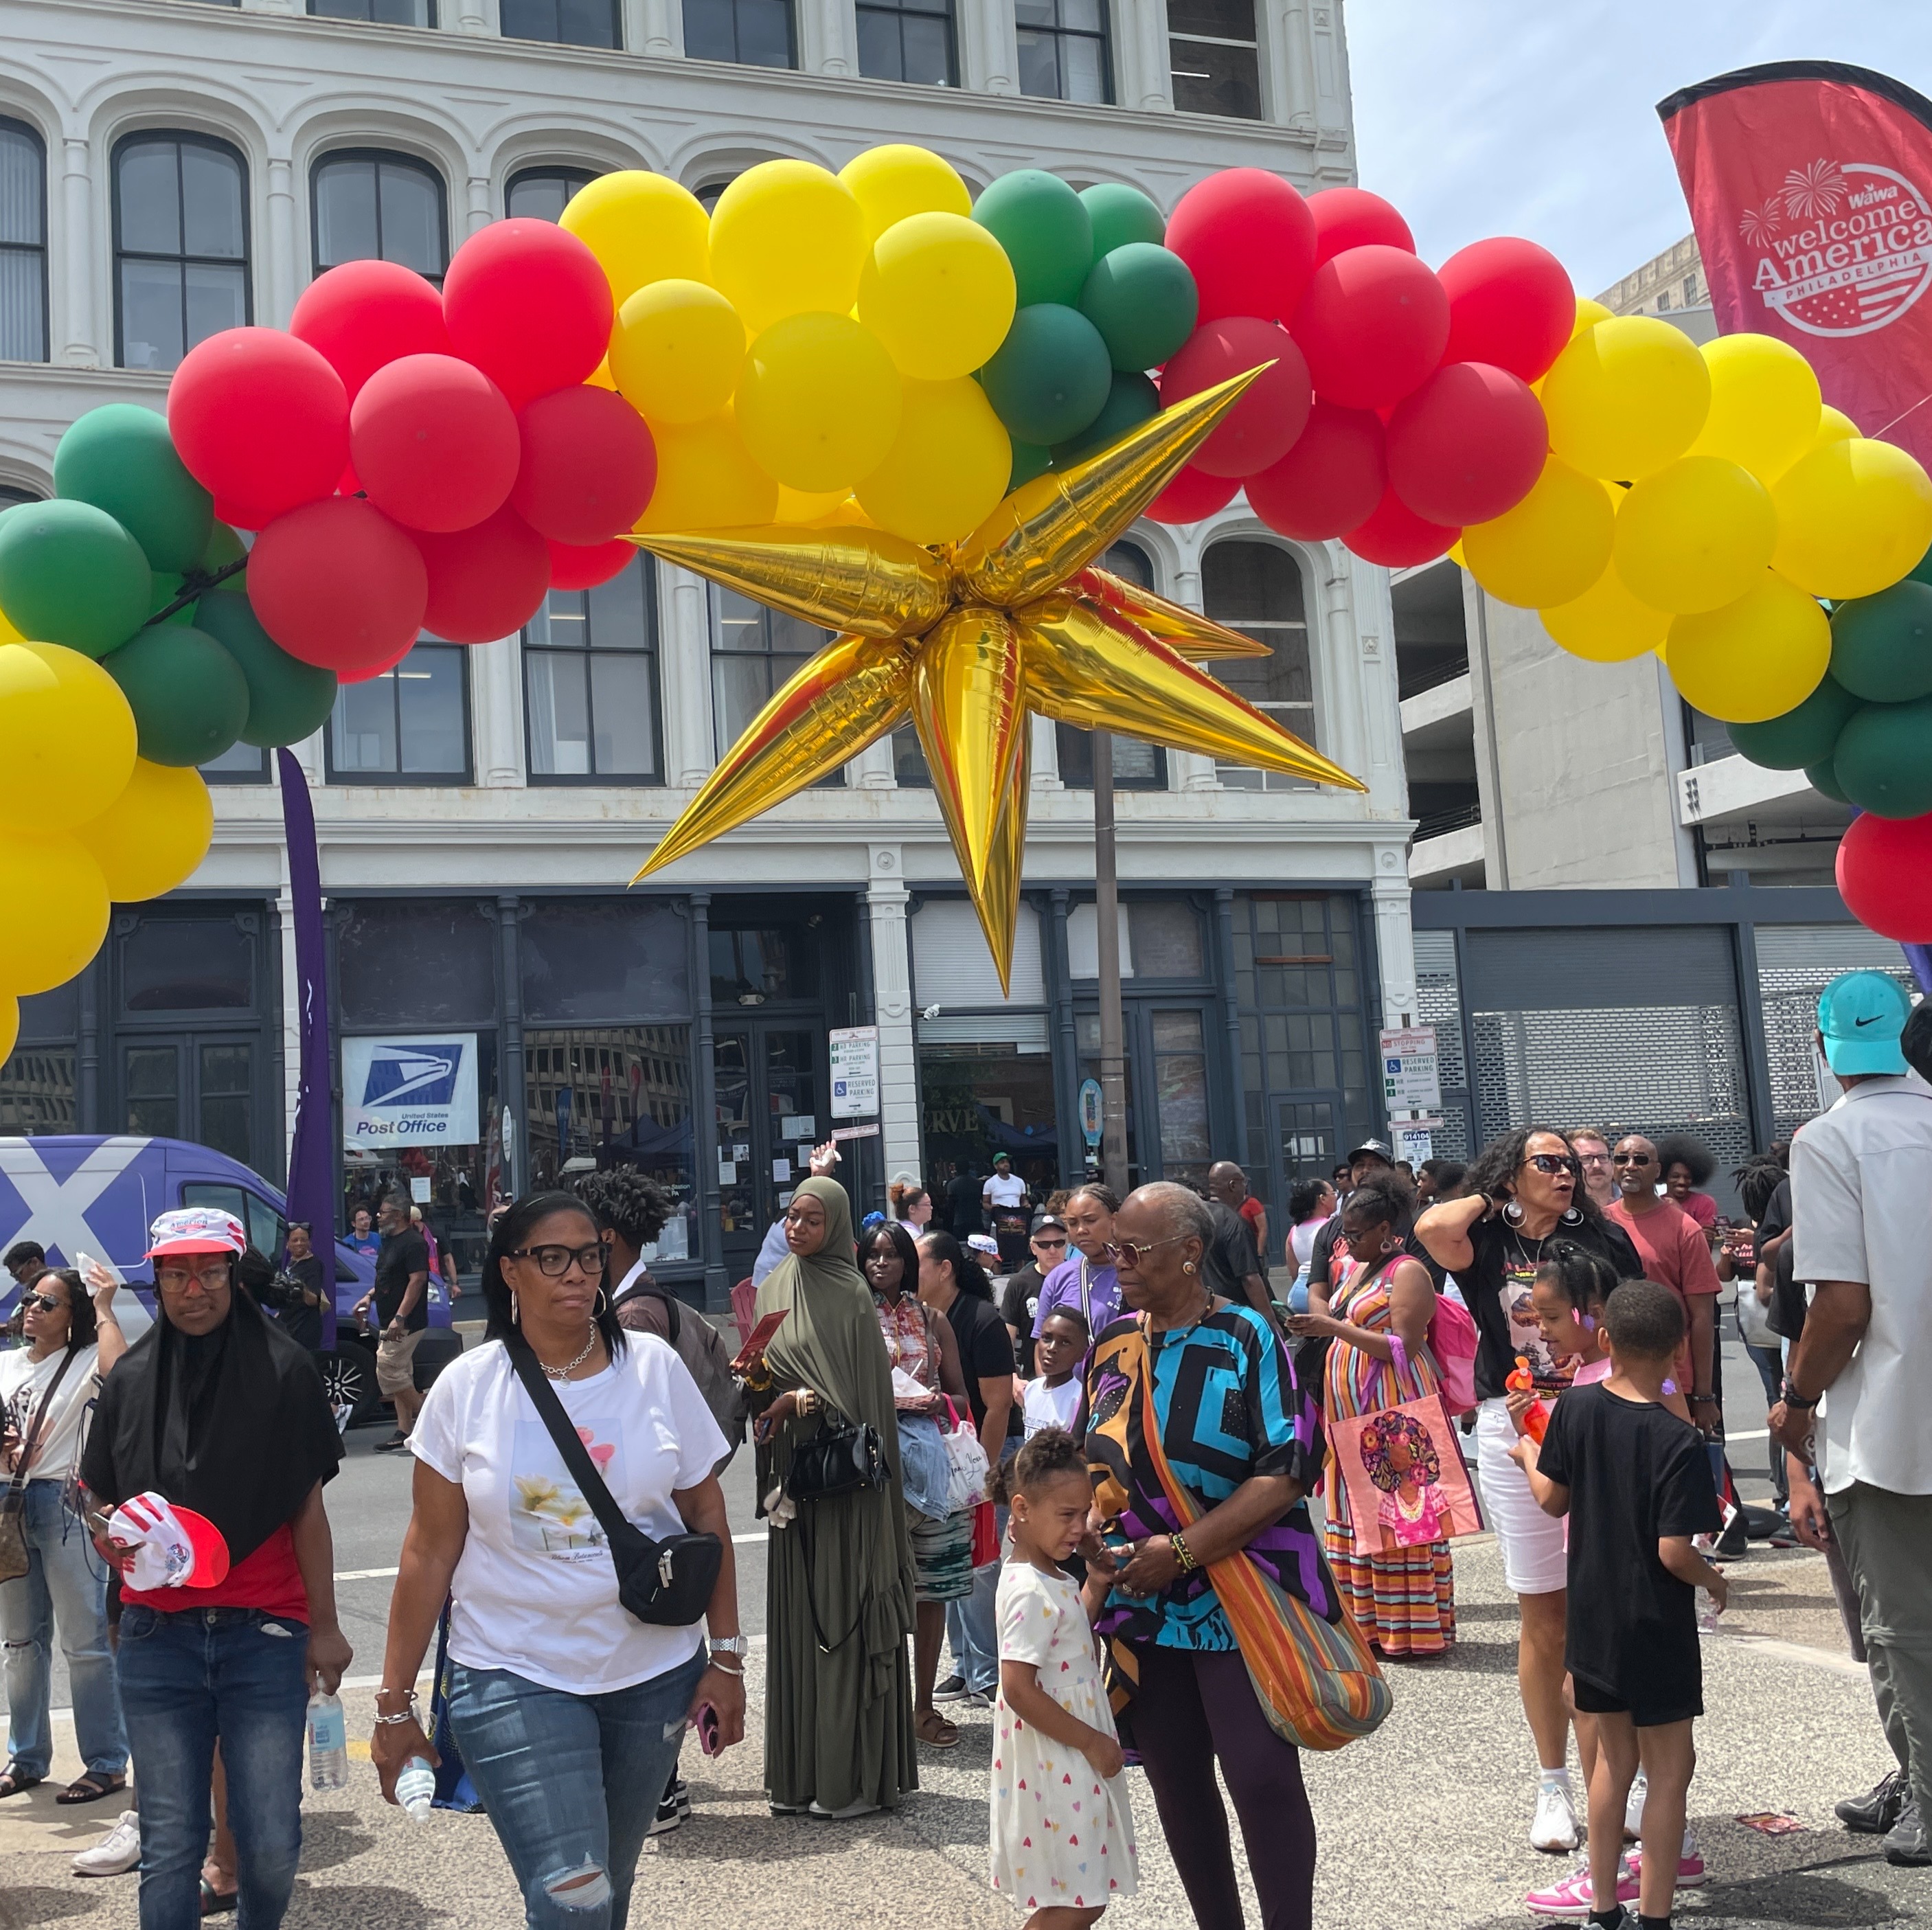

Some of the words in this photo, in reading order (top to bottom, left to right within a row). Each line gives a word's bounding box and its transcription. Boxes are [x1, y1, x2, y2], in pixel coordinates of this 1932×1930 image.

[1848, 185, 1898, 209] Wawa
[1772, 200, 1917, 258] welcome
[1752, 218, 1932, 290] America
[1786, 252, 1921, 299] PHILADELPHIA
[1393, 1038, 1425, 1047] STOPPING
[848, 1079, 876, 1088] RESERVED
[850, 1088, 874, 1096] PARKING
[356, 1121, 395, 1135] Post
[397, 1120, 446, 1133] Office
